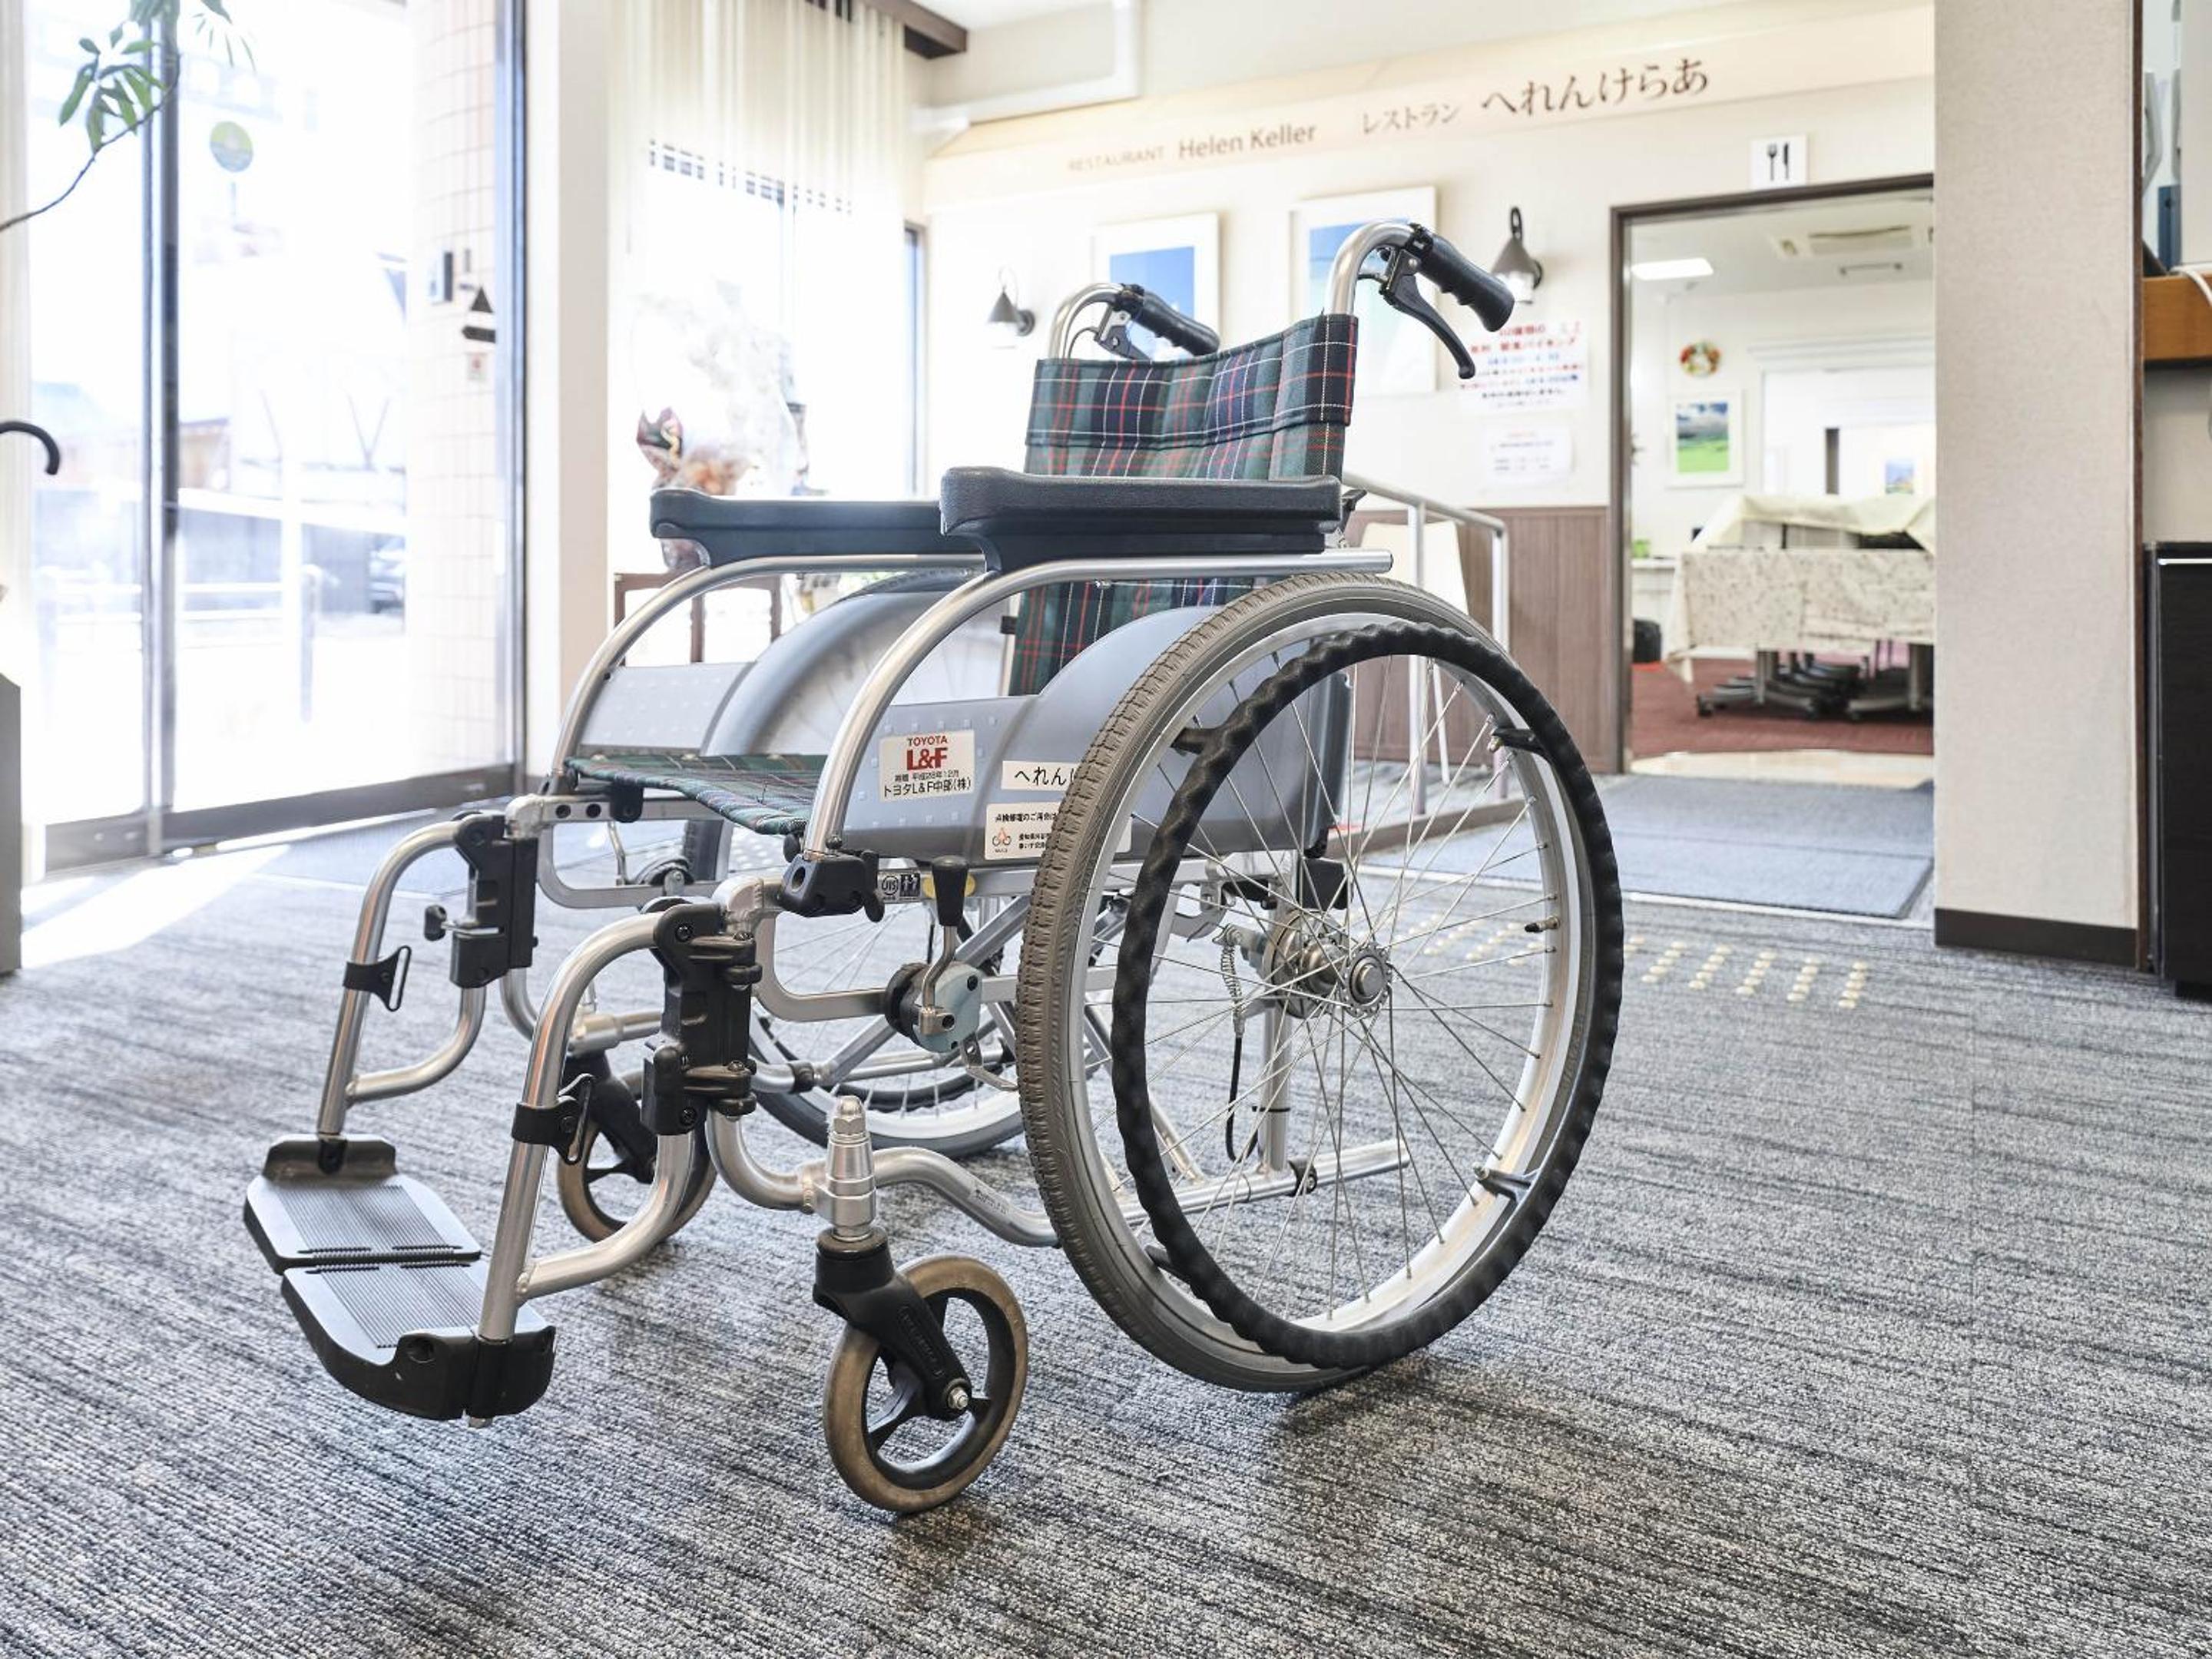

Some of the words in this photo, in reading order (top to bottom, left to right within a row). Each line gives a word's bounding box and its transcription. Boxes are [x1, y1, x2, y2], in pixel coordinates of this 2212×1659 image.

[1363, 103, 1463, 135] レストラン
[1481, 58, 1710, 118] へれんけらあ
[1068, 144, 1165, 171] RESTAURANT
[1178, 136, 1243, 160] Helen
[1250, 123, 1317, 150] Keller
[906, 747, 949, 771] L&F
[907, 735, 948, 747] TOYOTA
